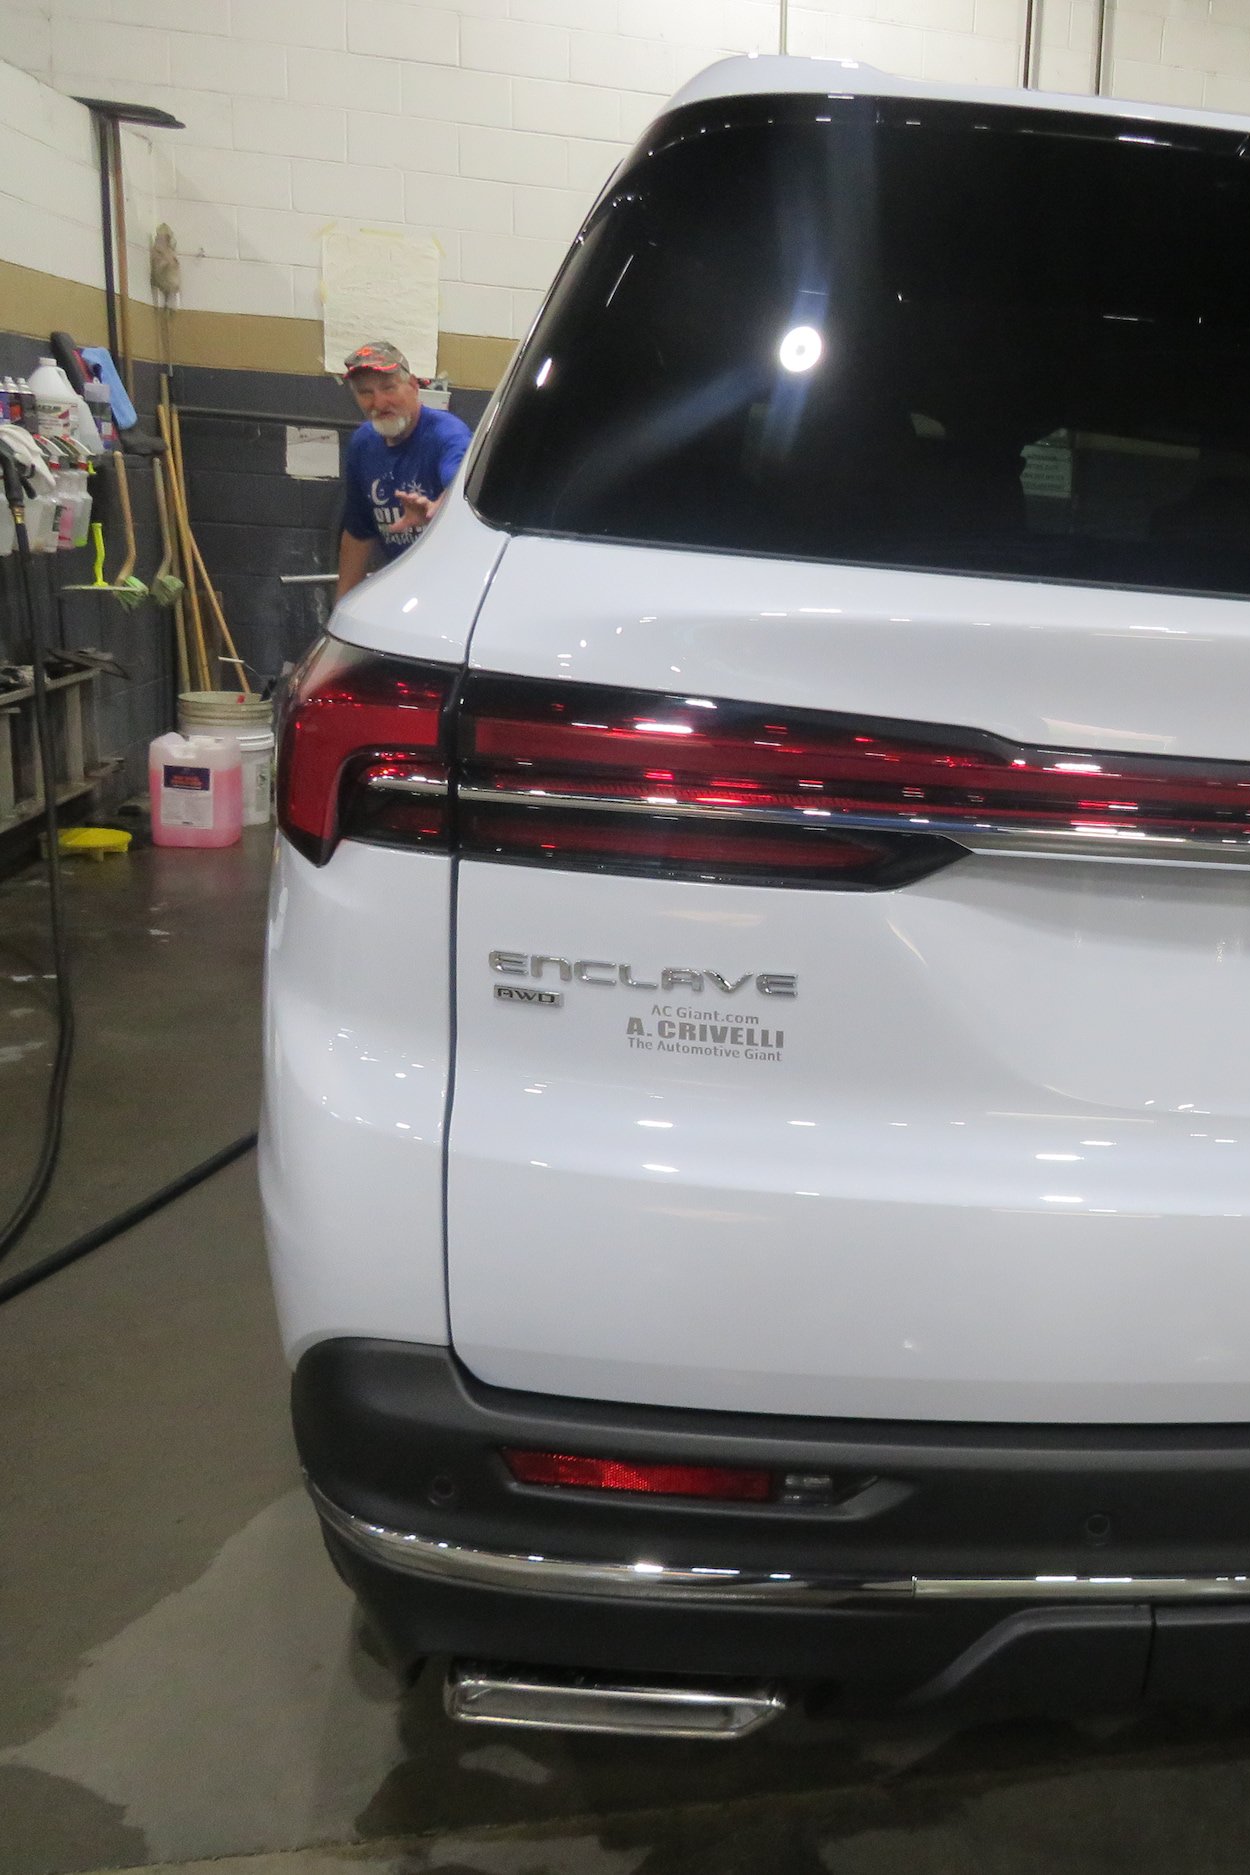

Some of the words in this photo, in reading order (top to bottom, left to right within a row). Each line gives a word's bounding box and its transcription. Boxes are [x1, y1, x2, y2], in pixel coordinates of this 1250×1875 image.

[488, 949, 799, 998] ENCLAVE
[496, 987, 556, 1004] AWD
[651, 1004, 673, 1018] AC
[676, 1006, 760, 1025] Giant.com
[626, 1016, 653, 1037] A.
[657, 1020, 785, 1049] CRIVELLI
[627, 1037, 653, 1050] The
[657, 1040, 741, 1059] Automotive
[744, 1048, 783, 1062] Giant
